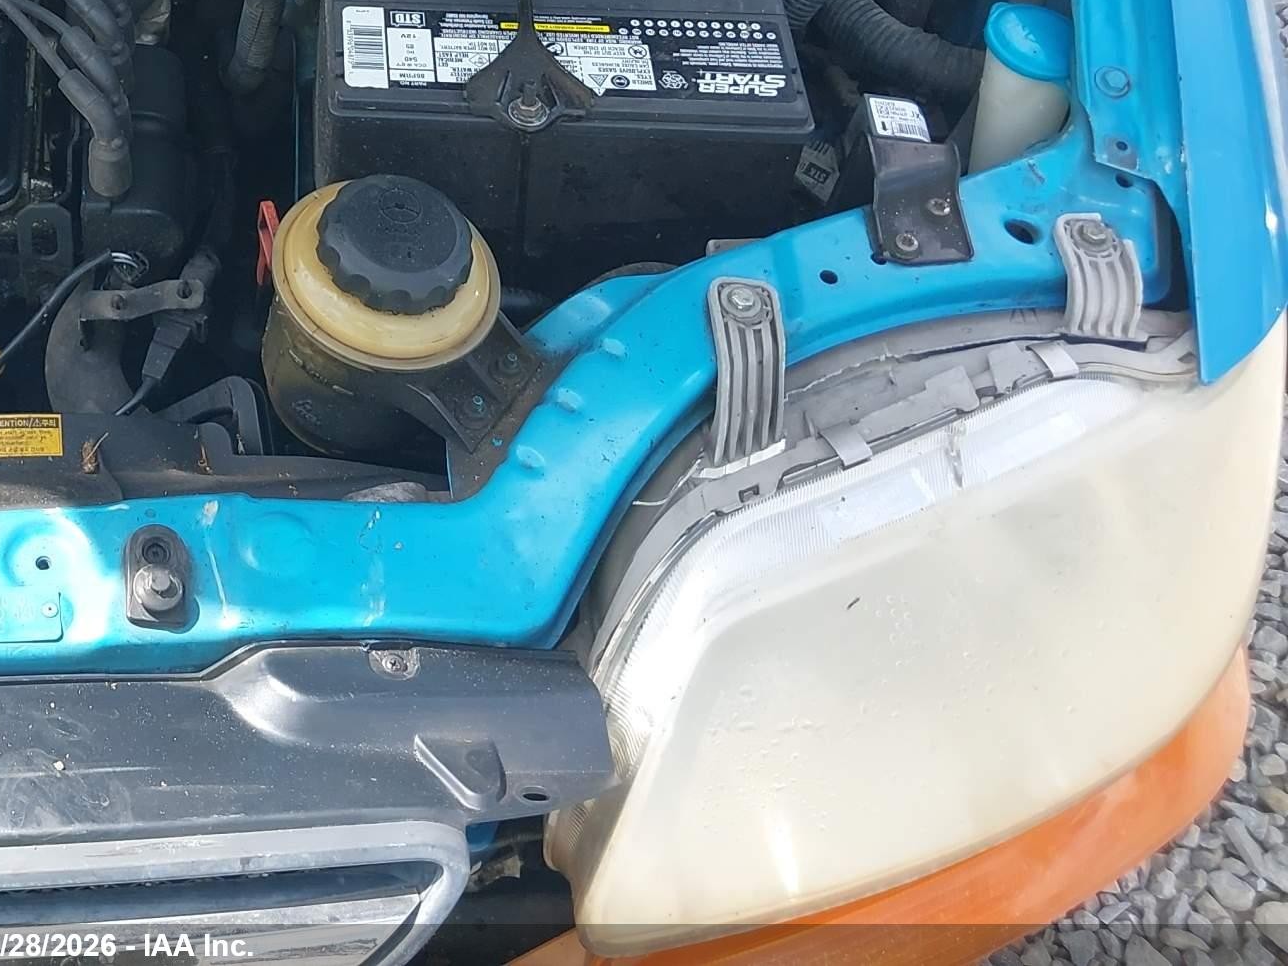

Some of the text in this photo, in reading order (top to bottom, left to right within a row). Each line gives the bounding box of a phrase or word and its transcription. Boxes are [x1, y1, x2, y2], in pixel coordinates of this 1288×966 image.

[395, 13, 421, 24] STD
[696, 74, 786, 88] START
[698, 83, 778, 96] SUPER
